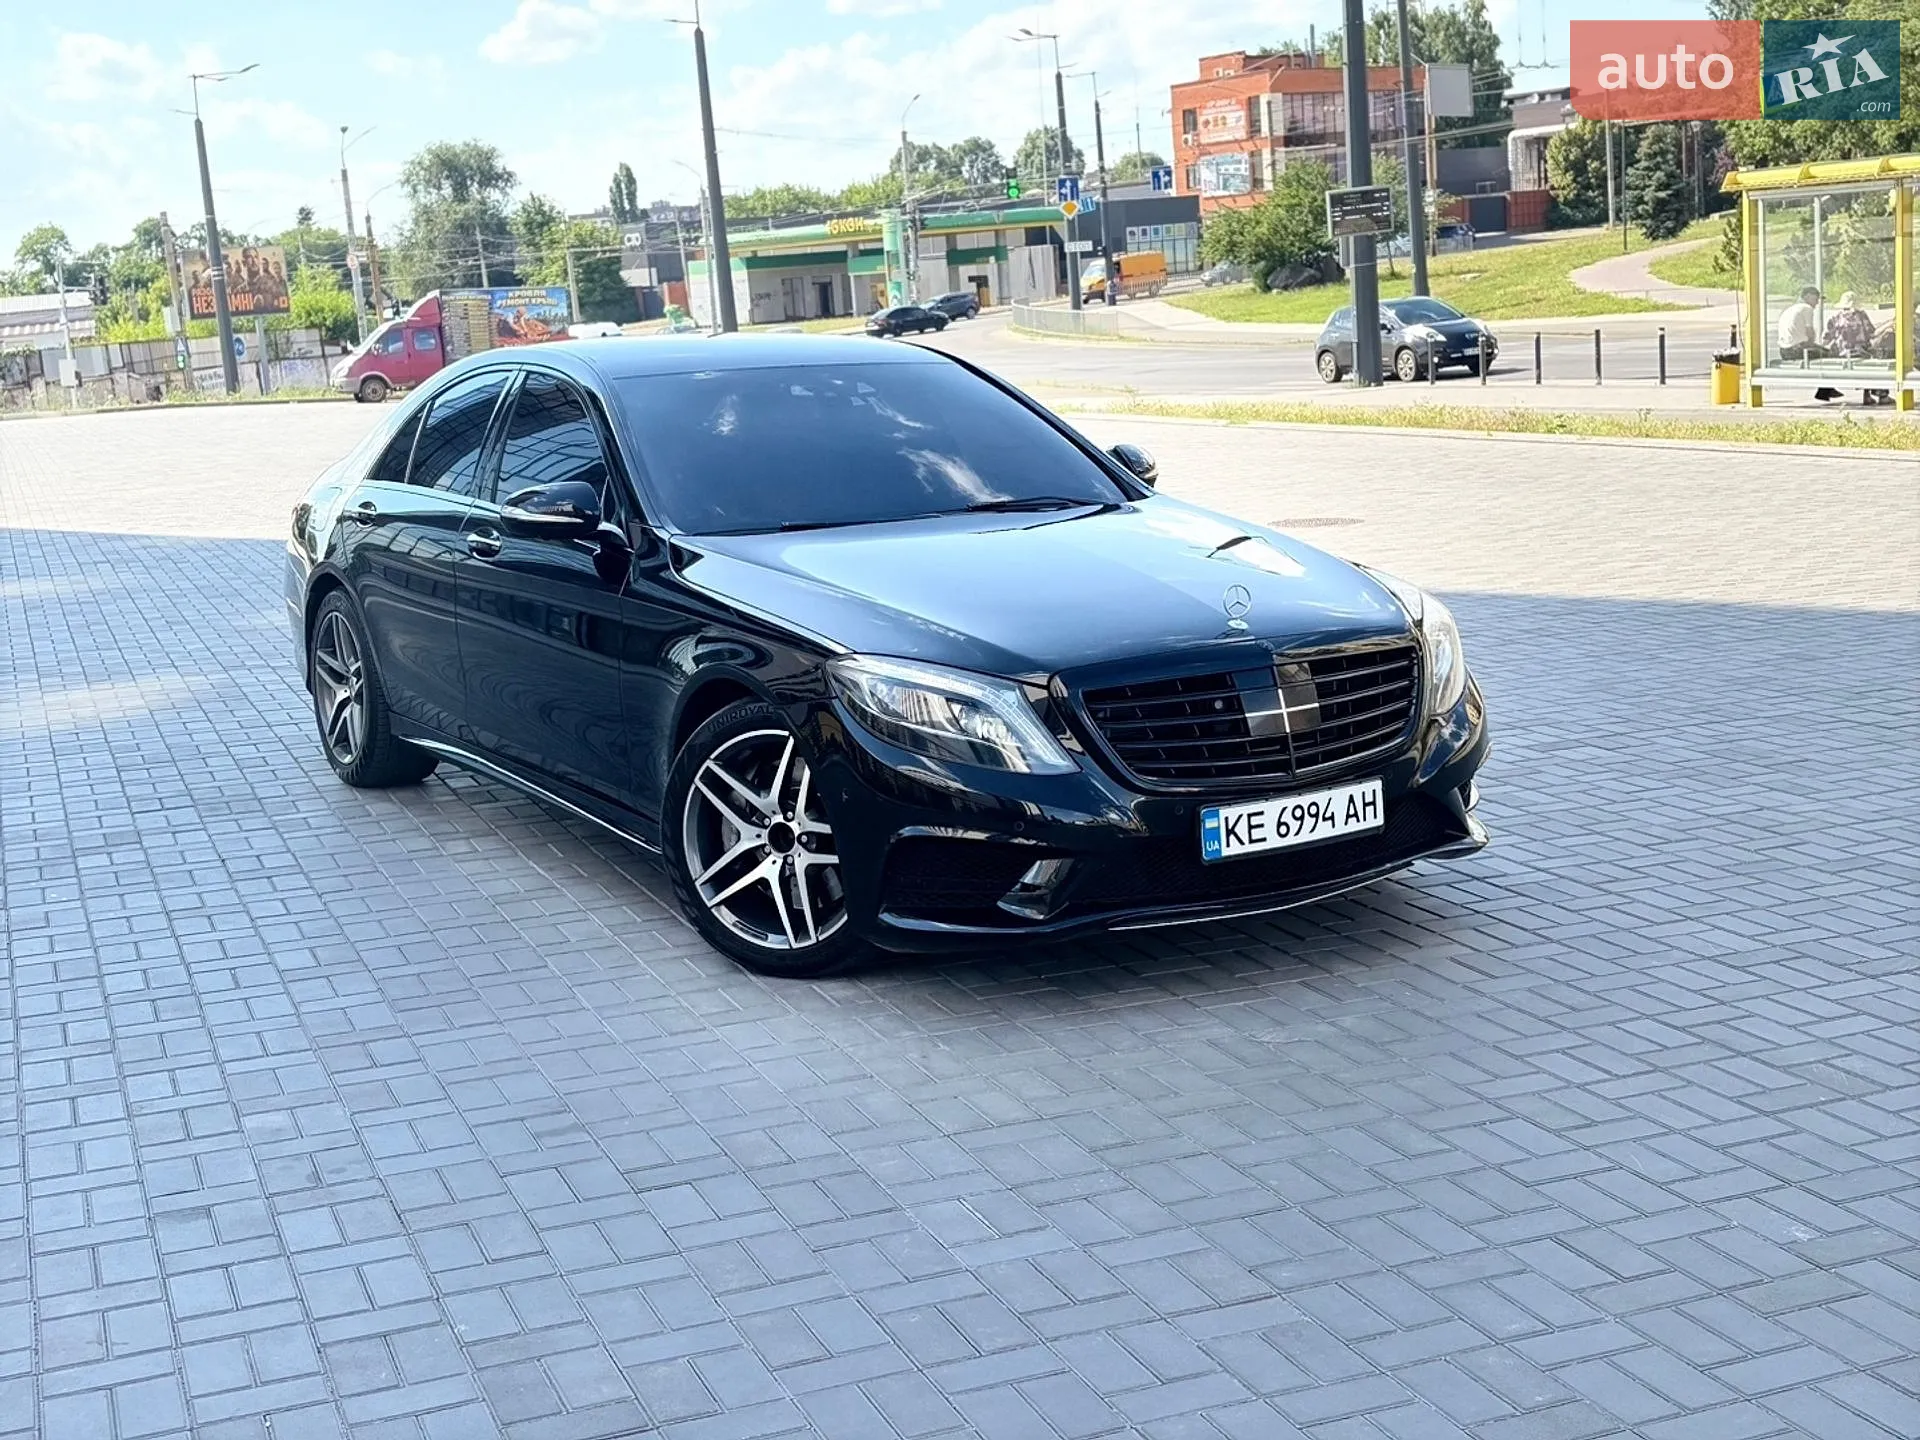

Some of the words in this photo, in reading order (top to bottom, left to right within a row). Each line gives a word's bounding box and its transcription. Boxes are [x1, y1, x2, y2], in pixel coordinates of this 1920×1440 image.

[192, 292, 255, 314] НЕЗМНІ
[707, 704, 774, 733] UNIROYAL
[1224, 811, 1267, 848] KE
[1276, 797, 1336, 838] 6994
[1344, 789, 1377, 826] AH
[1206, 840, 1220, 852] UA
